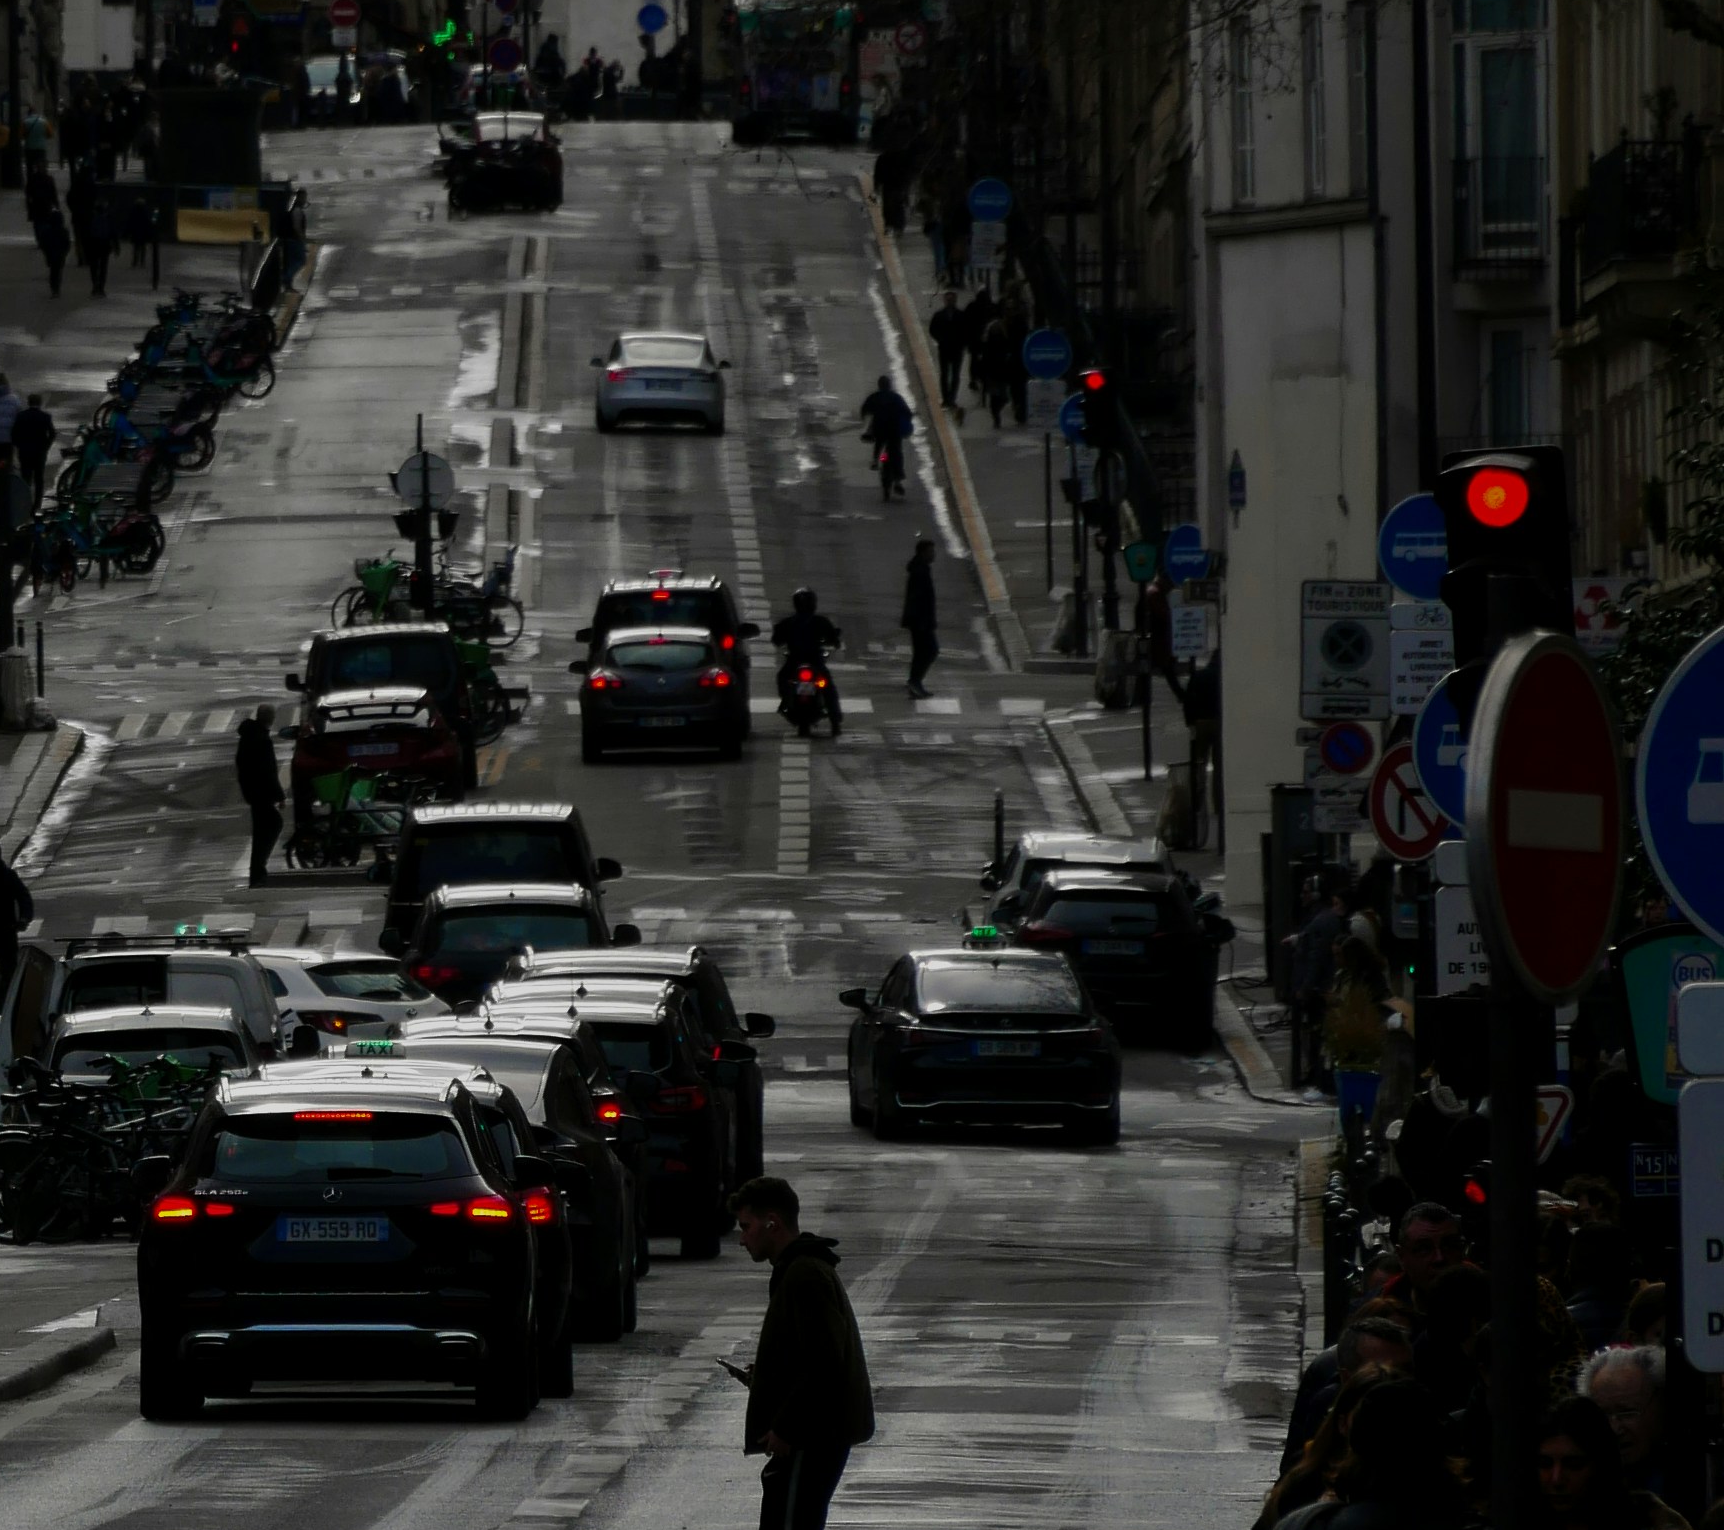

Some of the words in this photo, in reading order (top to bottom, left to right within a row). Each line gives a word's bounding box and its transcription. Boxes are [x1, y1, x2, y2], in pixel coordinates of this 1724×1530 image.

[1310, 586, 1332, 597] FIN
[1348, 586, 1382, 597] ZONE
[1307, 601, 1386, 612] TOURISTIQUE
[1457, 923, 1479, 935] AUT
[1448, 962, 1465, 974] DE
[1679, 965, 1710, 981] BUS
[357, 1043, 393, 1055] TAXI
